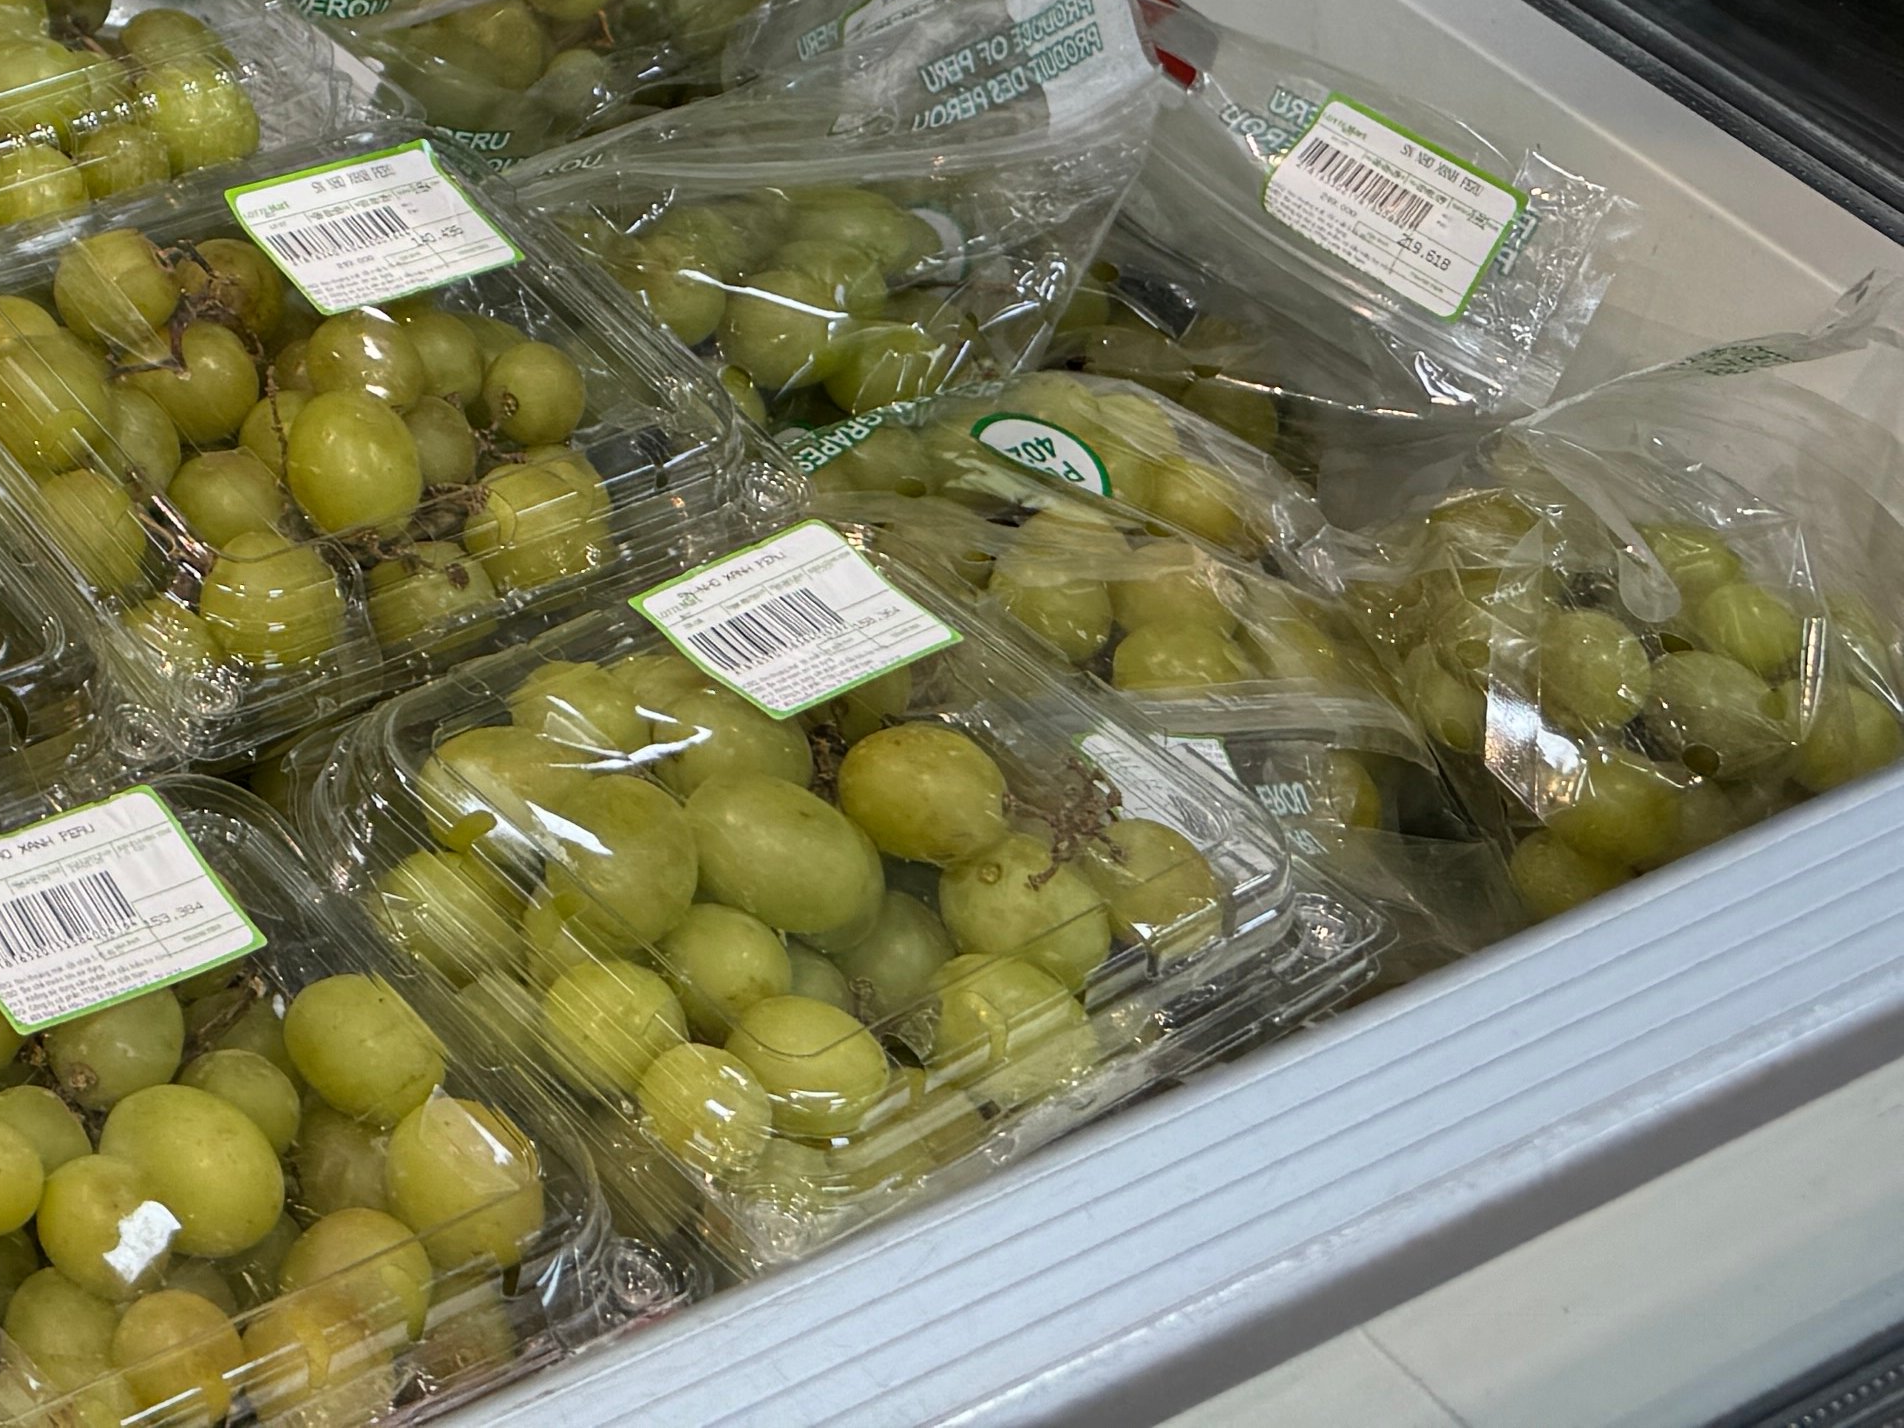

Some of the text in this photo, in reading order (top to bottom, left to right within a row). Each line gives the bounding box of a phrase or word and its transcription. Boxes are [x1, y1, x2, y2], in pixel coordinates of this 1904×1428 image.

[1396, 232, 1452, 272] 219.618
[18, 835, 55, 856] XANH
[59, 824, 96, 843] PERU
